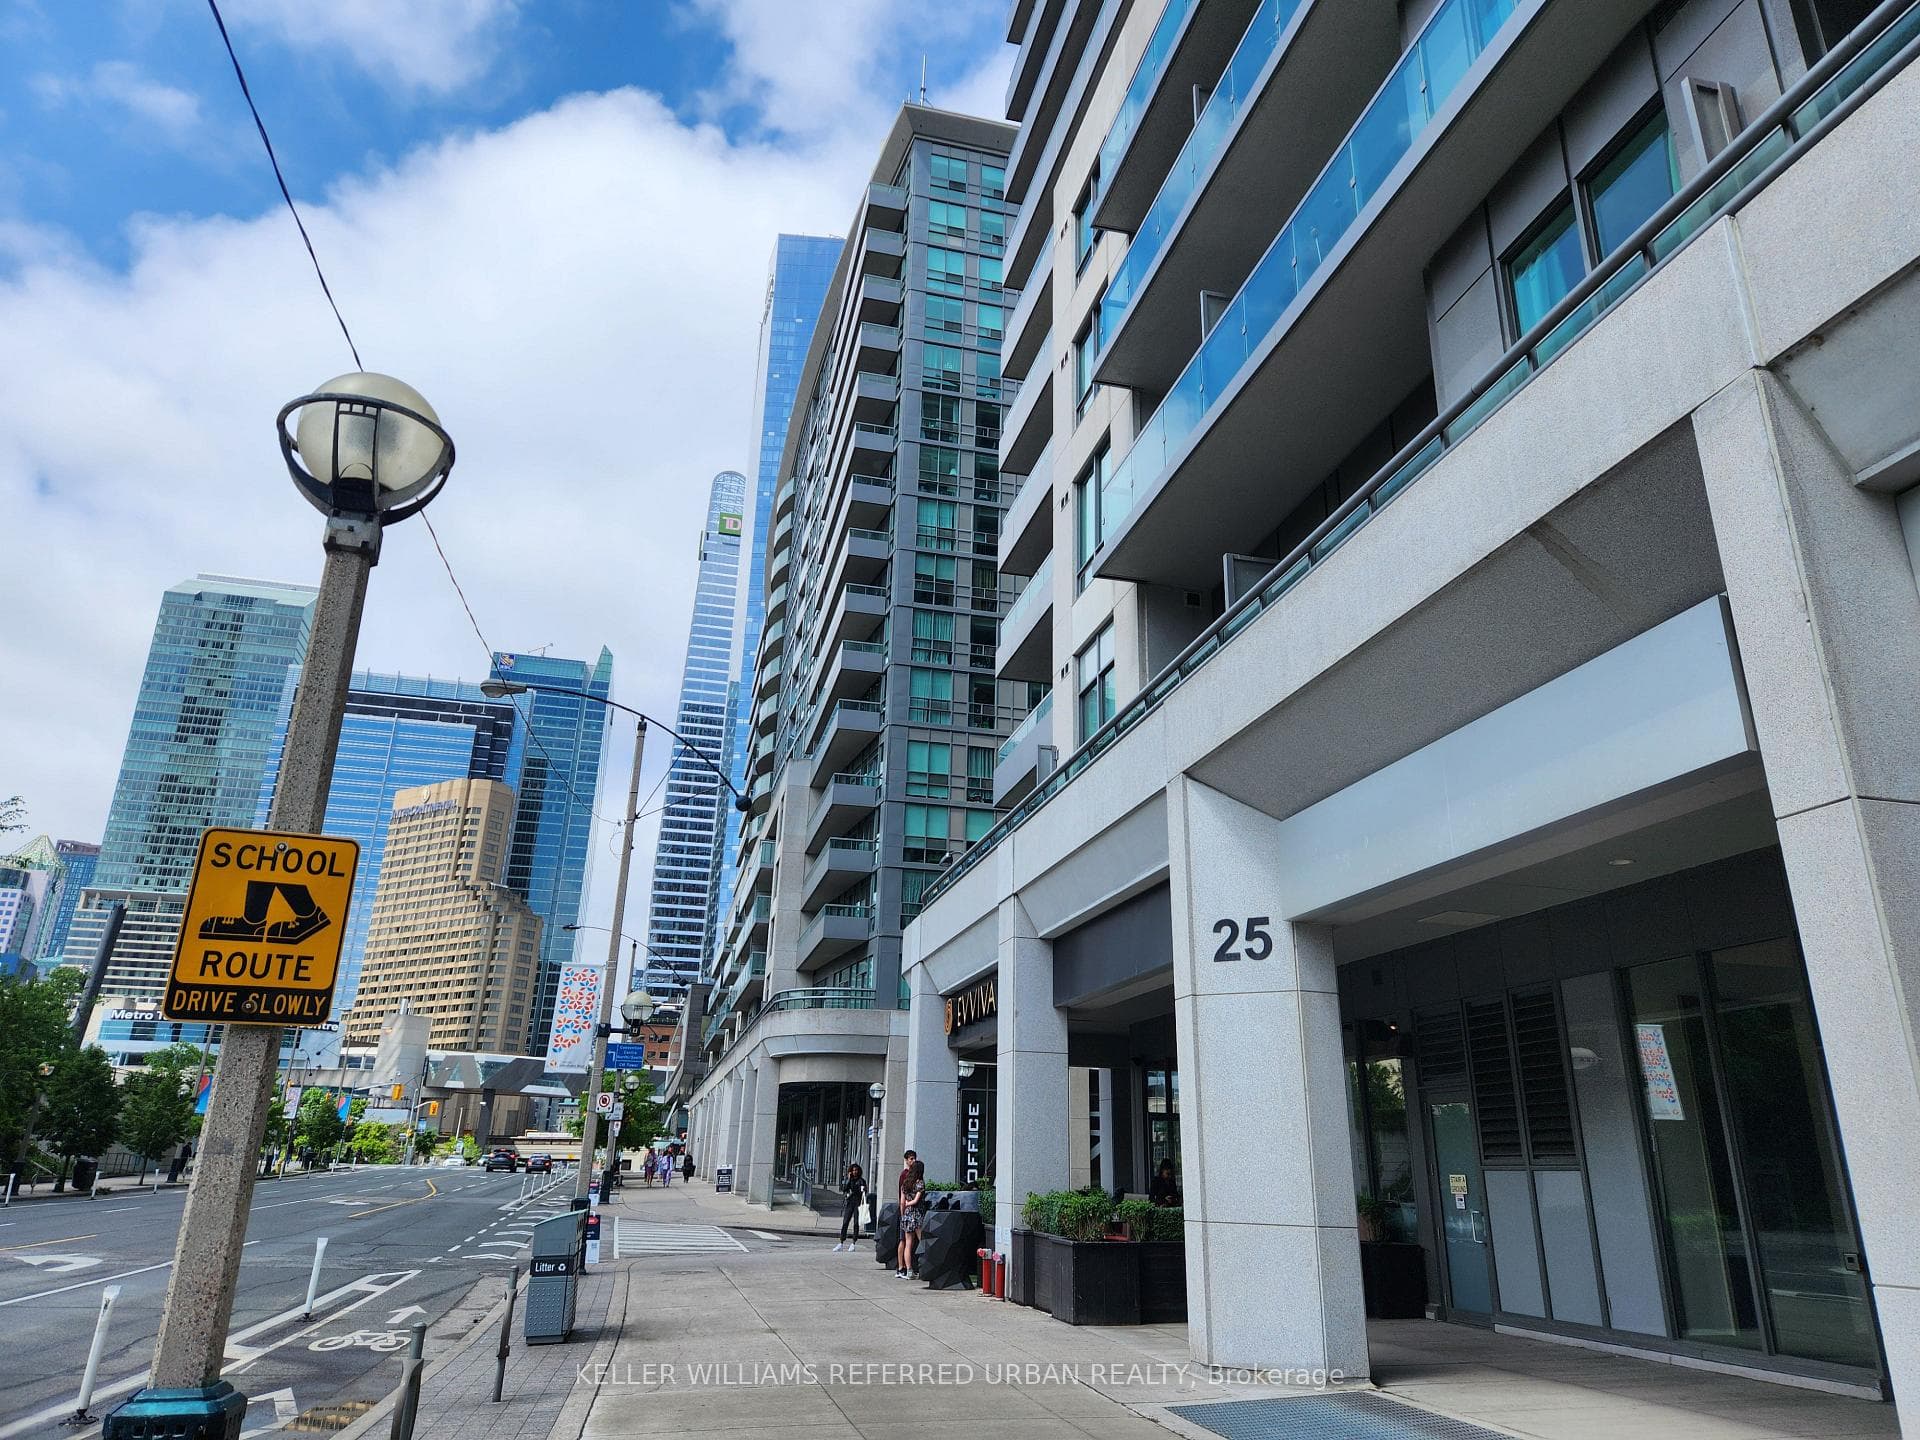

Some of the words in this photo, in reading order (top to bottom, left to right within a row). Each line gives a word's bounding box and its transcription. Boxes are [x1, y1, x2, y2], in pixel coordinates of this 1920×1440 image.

[210, 842, 345, 878] SCHOOL
[1212, 916, 1273, 962] 25
[199, 950, 314, 981] ROUTE
[110, 1009, 154, 1020] Metro
[172, 989, 237, 1013] DRIVE
[247, 992, 326, 1016] SLOWLY
[957, 980, 996, 1027] EVVIVA
[967, 1103, 980, 1183] OFFICE
[535, 1262, 556, 1273] Litter
